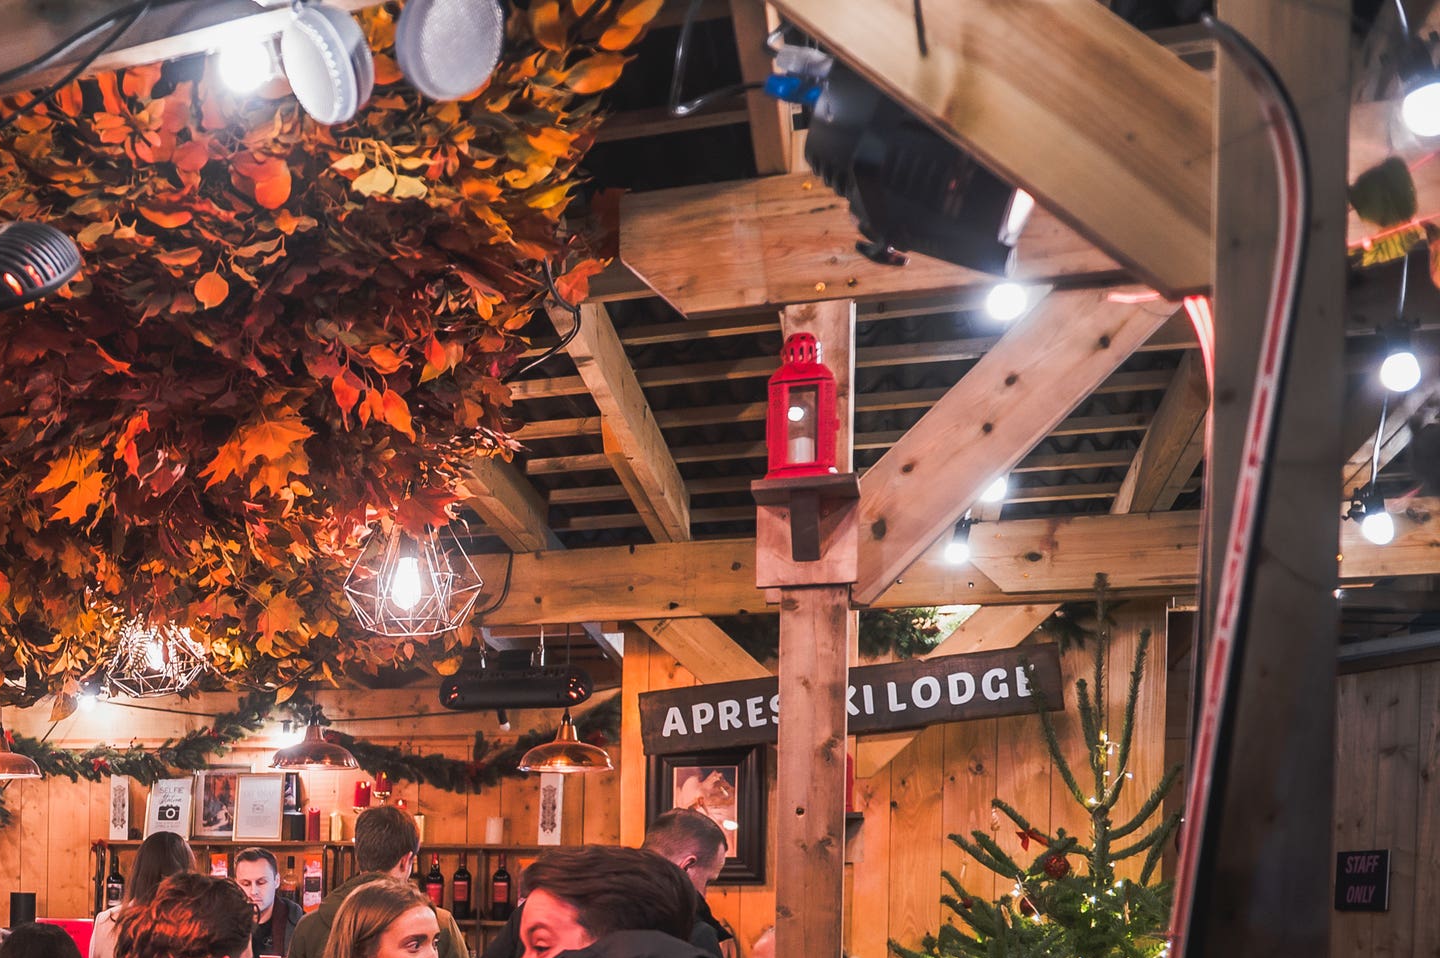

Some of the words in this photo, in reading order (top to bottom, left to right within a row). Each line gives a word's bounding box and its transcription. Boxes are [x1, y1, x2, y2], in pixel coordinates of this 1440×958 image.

[846, 684, 875, 716] KI
[1345, 855, 1380, 874] STAFF
[1346, 885, 1376, 904] ONLY
